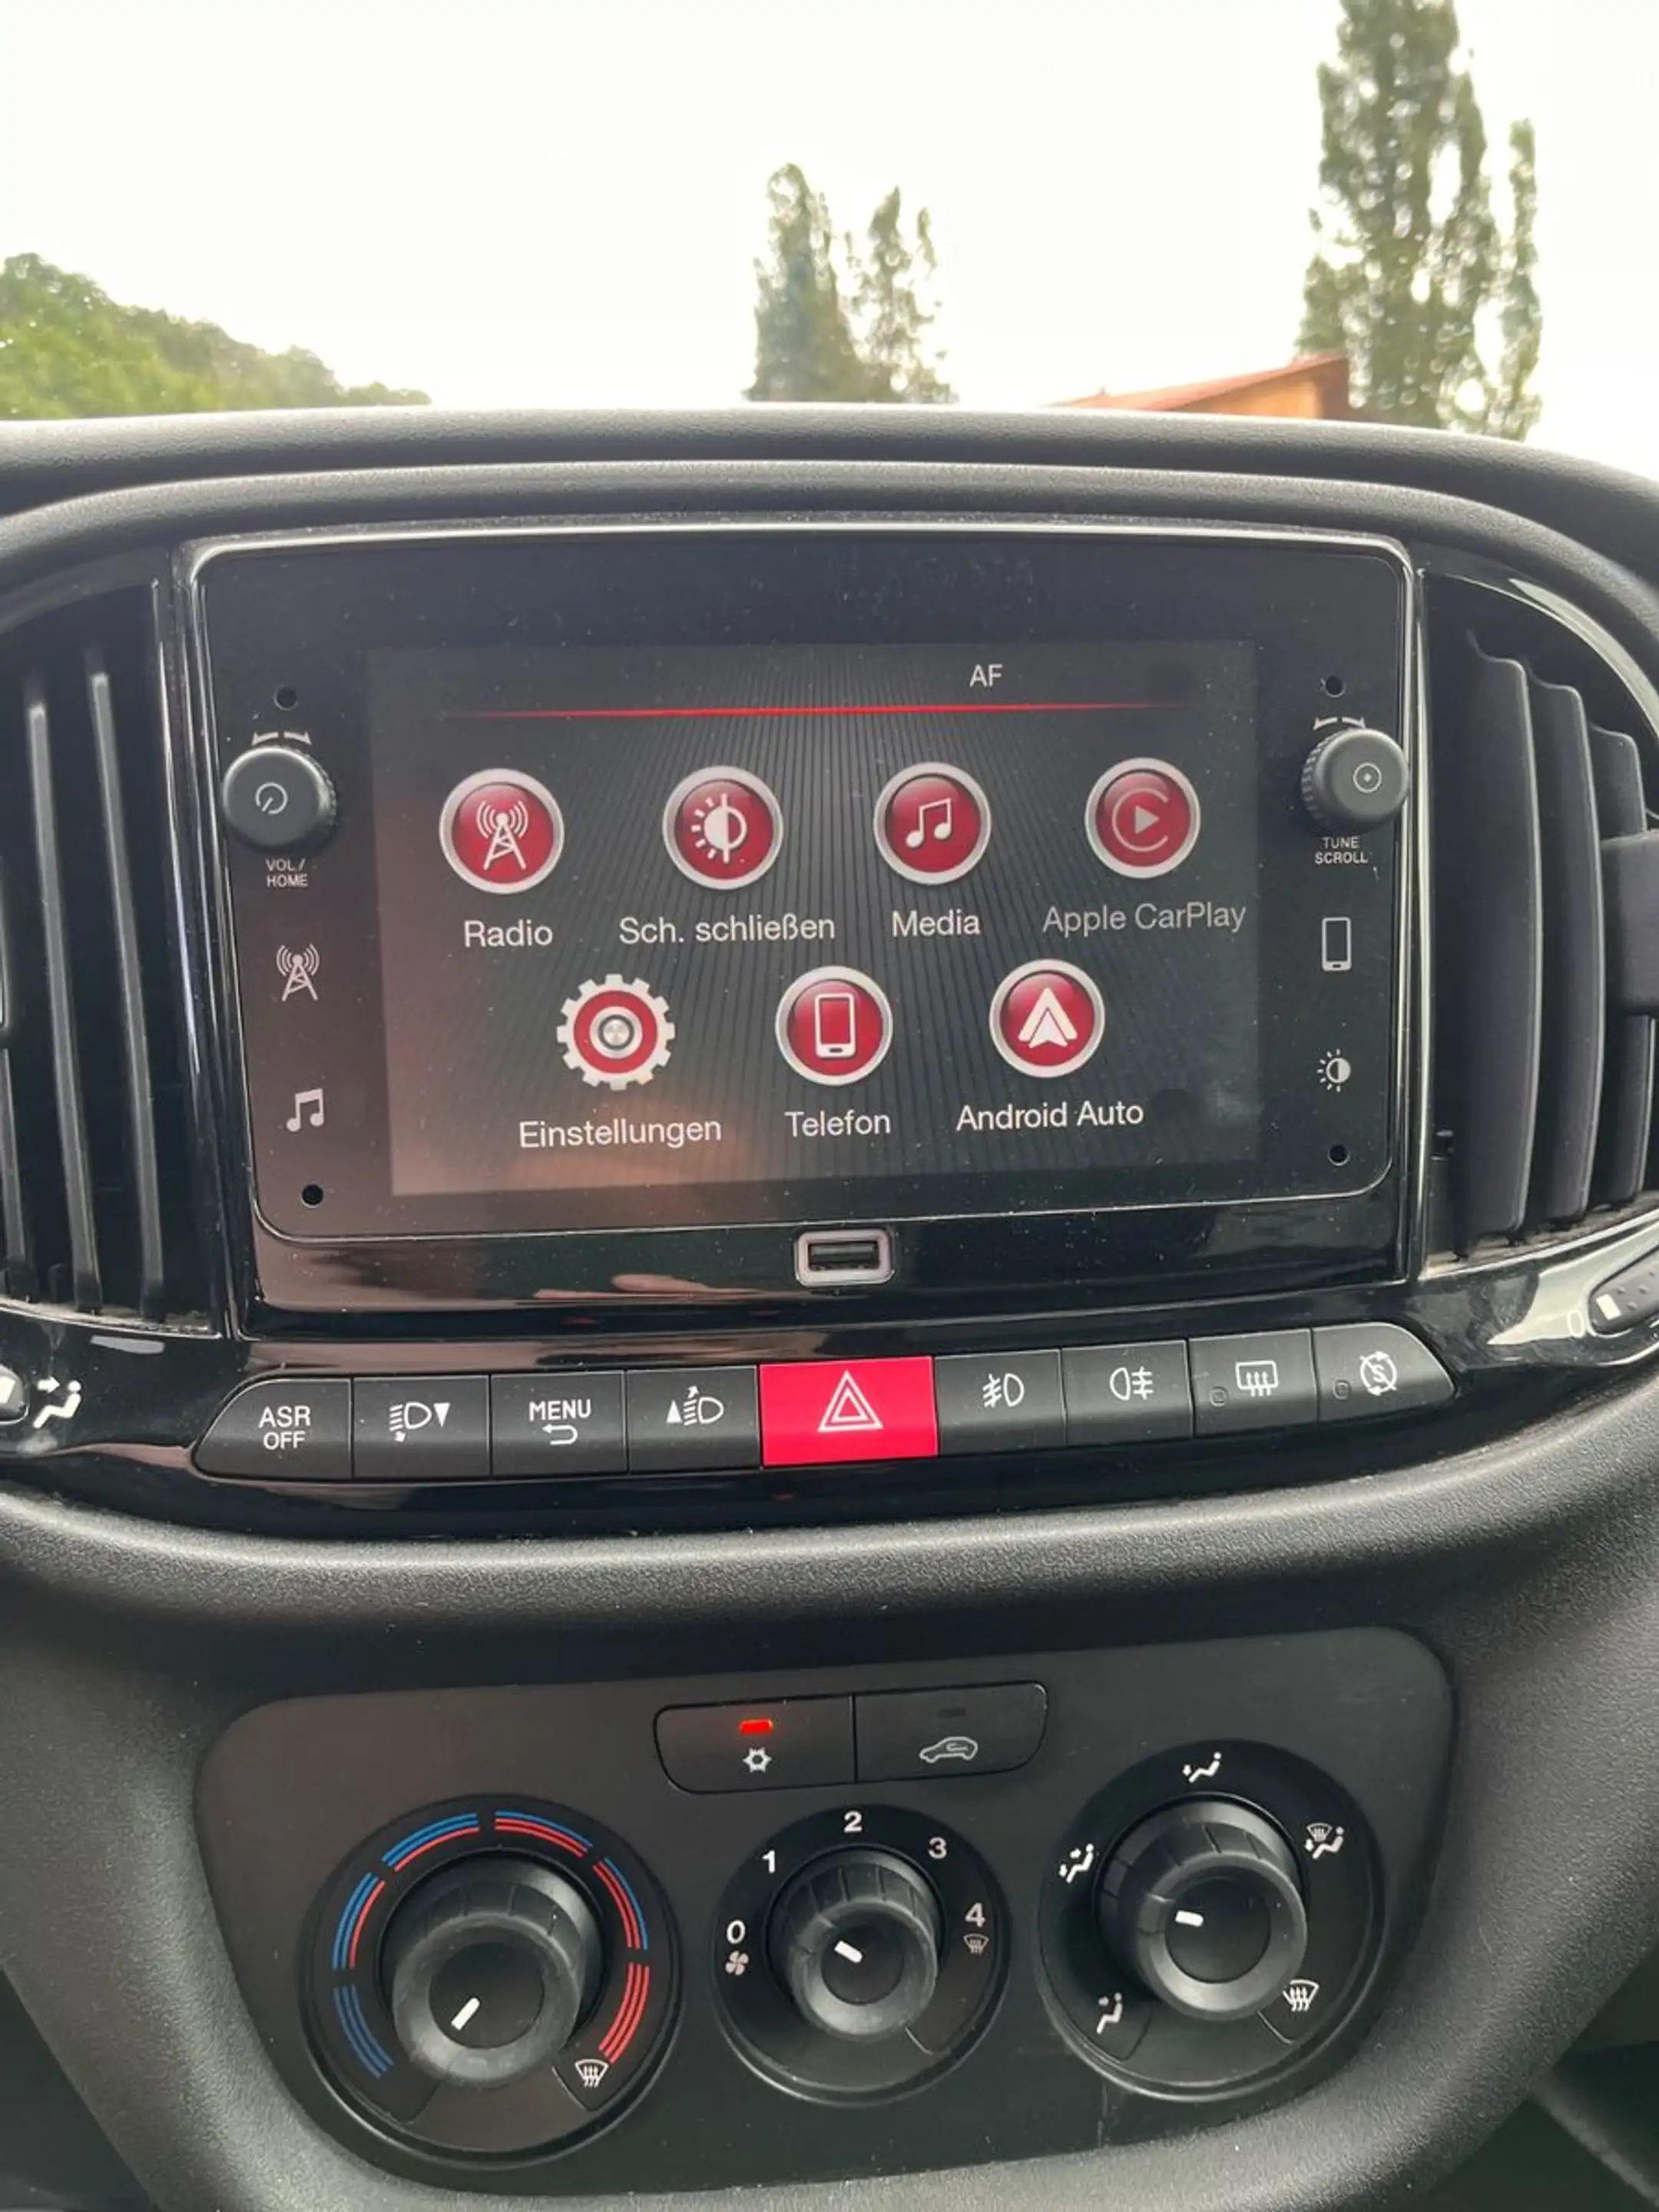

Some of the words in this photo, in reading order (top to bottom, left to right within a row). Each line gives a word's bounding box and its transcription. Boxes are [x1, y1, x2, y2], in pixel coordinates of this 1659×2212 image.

[970, 664, 1002, 687] AF
[1324, 836, 1358, 849] TUNE
[1315, 852, 1367, 864] SCROLL
[267, 873, 308, 888] HOME
[620, 917, 684, 944] Sch.
[696, 913, 834, 941] schließen
[892, 909, 980, 936] Media
[1043, 905, 1126, 935] Apple
[1135, 902, 1246, 932] CarPlay
[465, 919, 552, 947] Radio
[785, 1110, 890, 1137] Telefon
[957, 1102, 1067, 1131] Android
[1077, 1101, 1143, 1126] Auto
[520, 1118, 720, 1147] Einstellungen
[259, 1406, 310, 1428] ASR
[530, 1399, 591, 1421] MENU
[263, 1431, 305, 1449] OFF
[845, 1812, 862, 1832] 2
[929, 1837, 946, 1859] 3
[763, 1850, 775, 1873] 1
[965, 1903, 985, 1926] 4
[727, 1920, 745, 1943] 0
